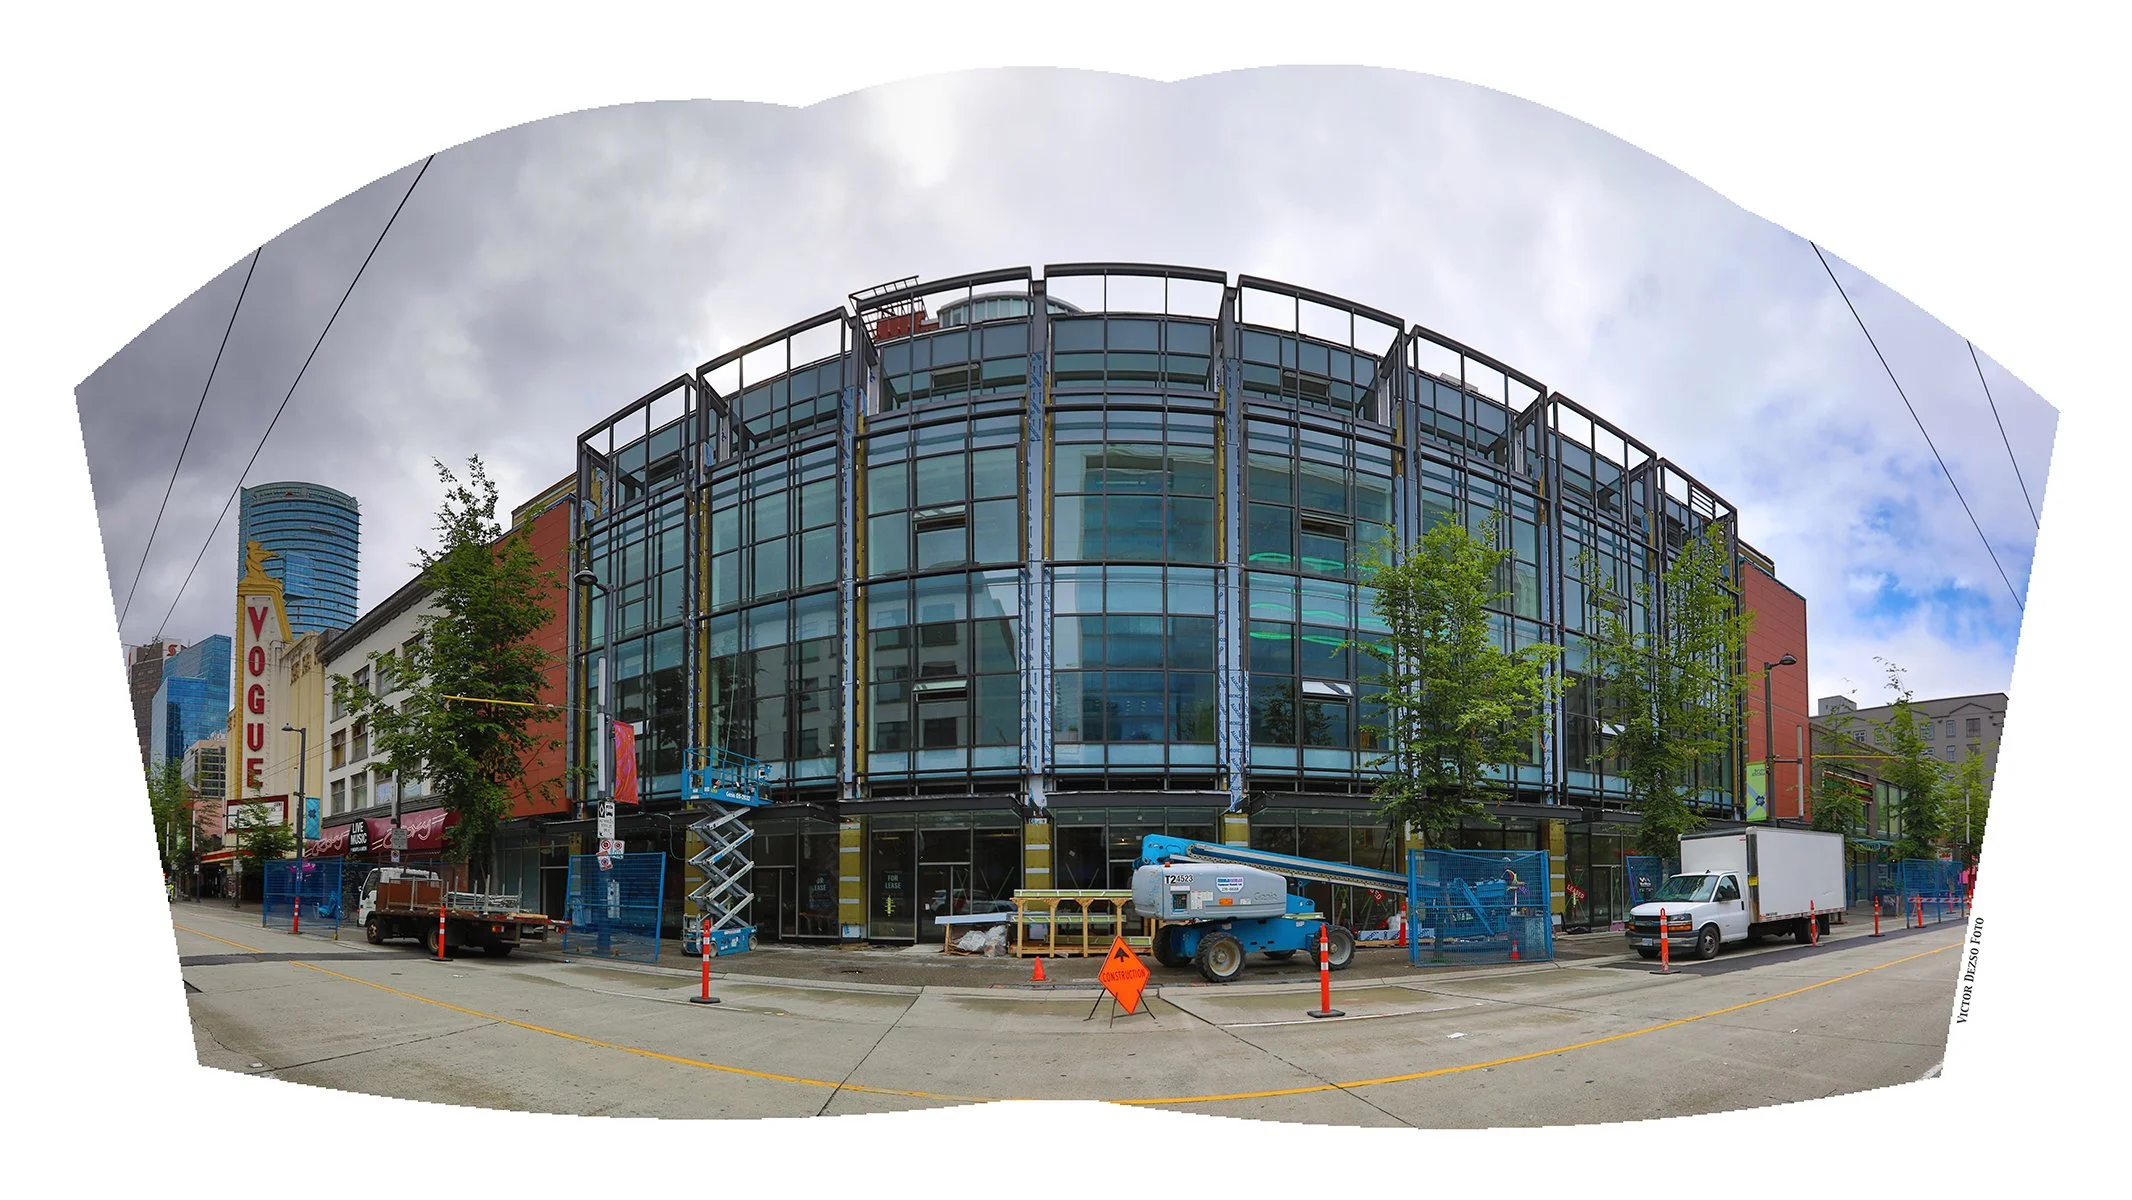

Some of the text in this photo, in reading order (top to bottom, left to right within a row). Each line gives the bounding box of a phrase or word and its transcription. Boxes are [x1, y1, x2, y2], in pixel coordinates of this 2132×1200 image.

[247, 606, 269, 788] VOGUE
[352, 821, 364, 834] LIVE
[350, 832, 368, 846] MUSIC
[887, 874, 899, 882] FOR
[1102, 968, 1146, 983] CONSTRUCTION
